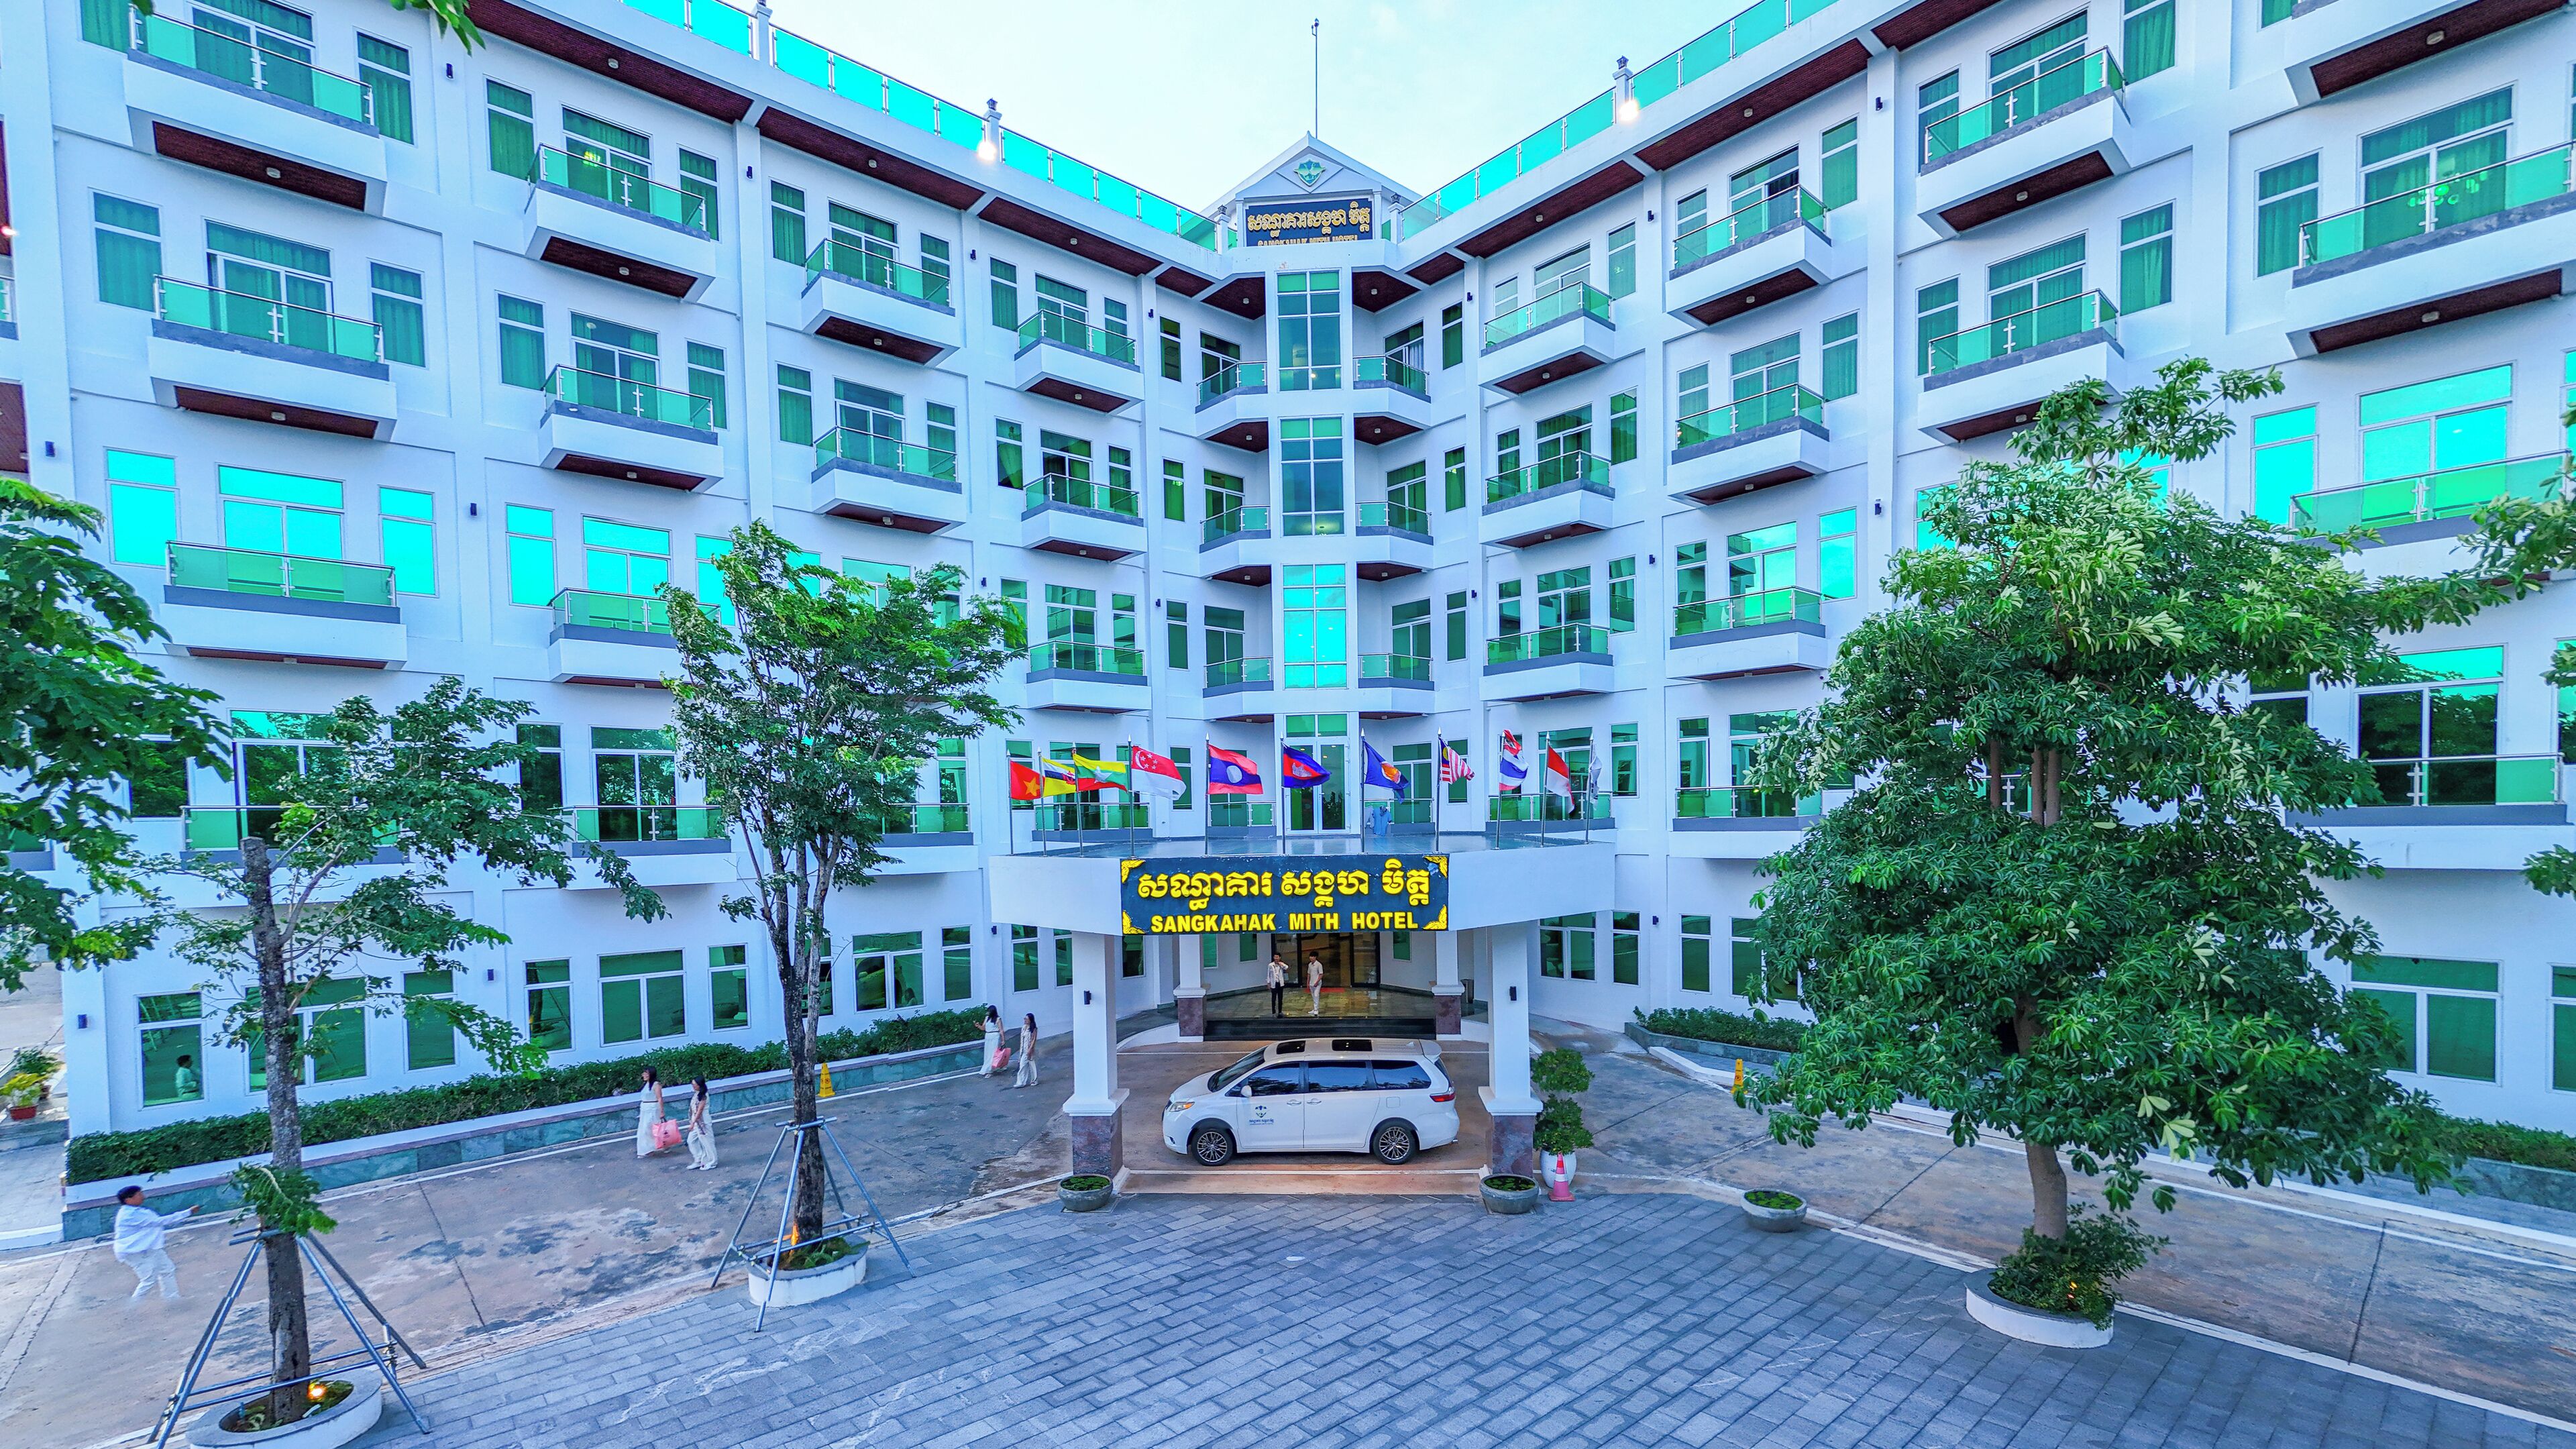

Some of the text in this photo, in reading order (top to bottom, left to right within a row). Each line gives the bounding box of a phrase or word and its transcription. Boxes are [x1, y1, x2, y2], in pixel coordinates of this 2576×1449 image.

[1138, 871, 1273, 911] សណ្ឋាគារ
[1381, 858, 1430, 906] មិត្ត
[1150, 912, 1418, 932] SANGKAHAK MITH HOTEL
